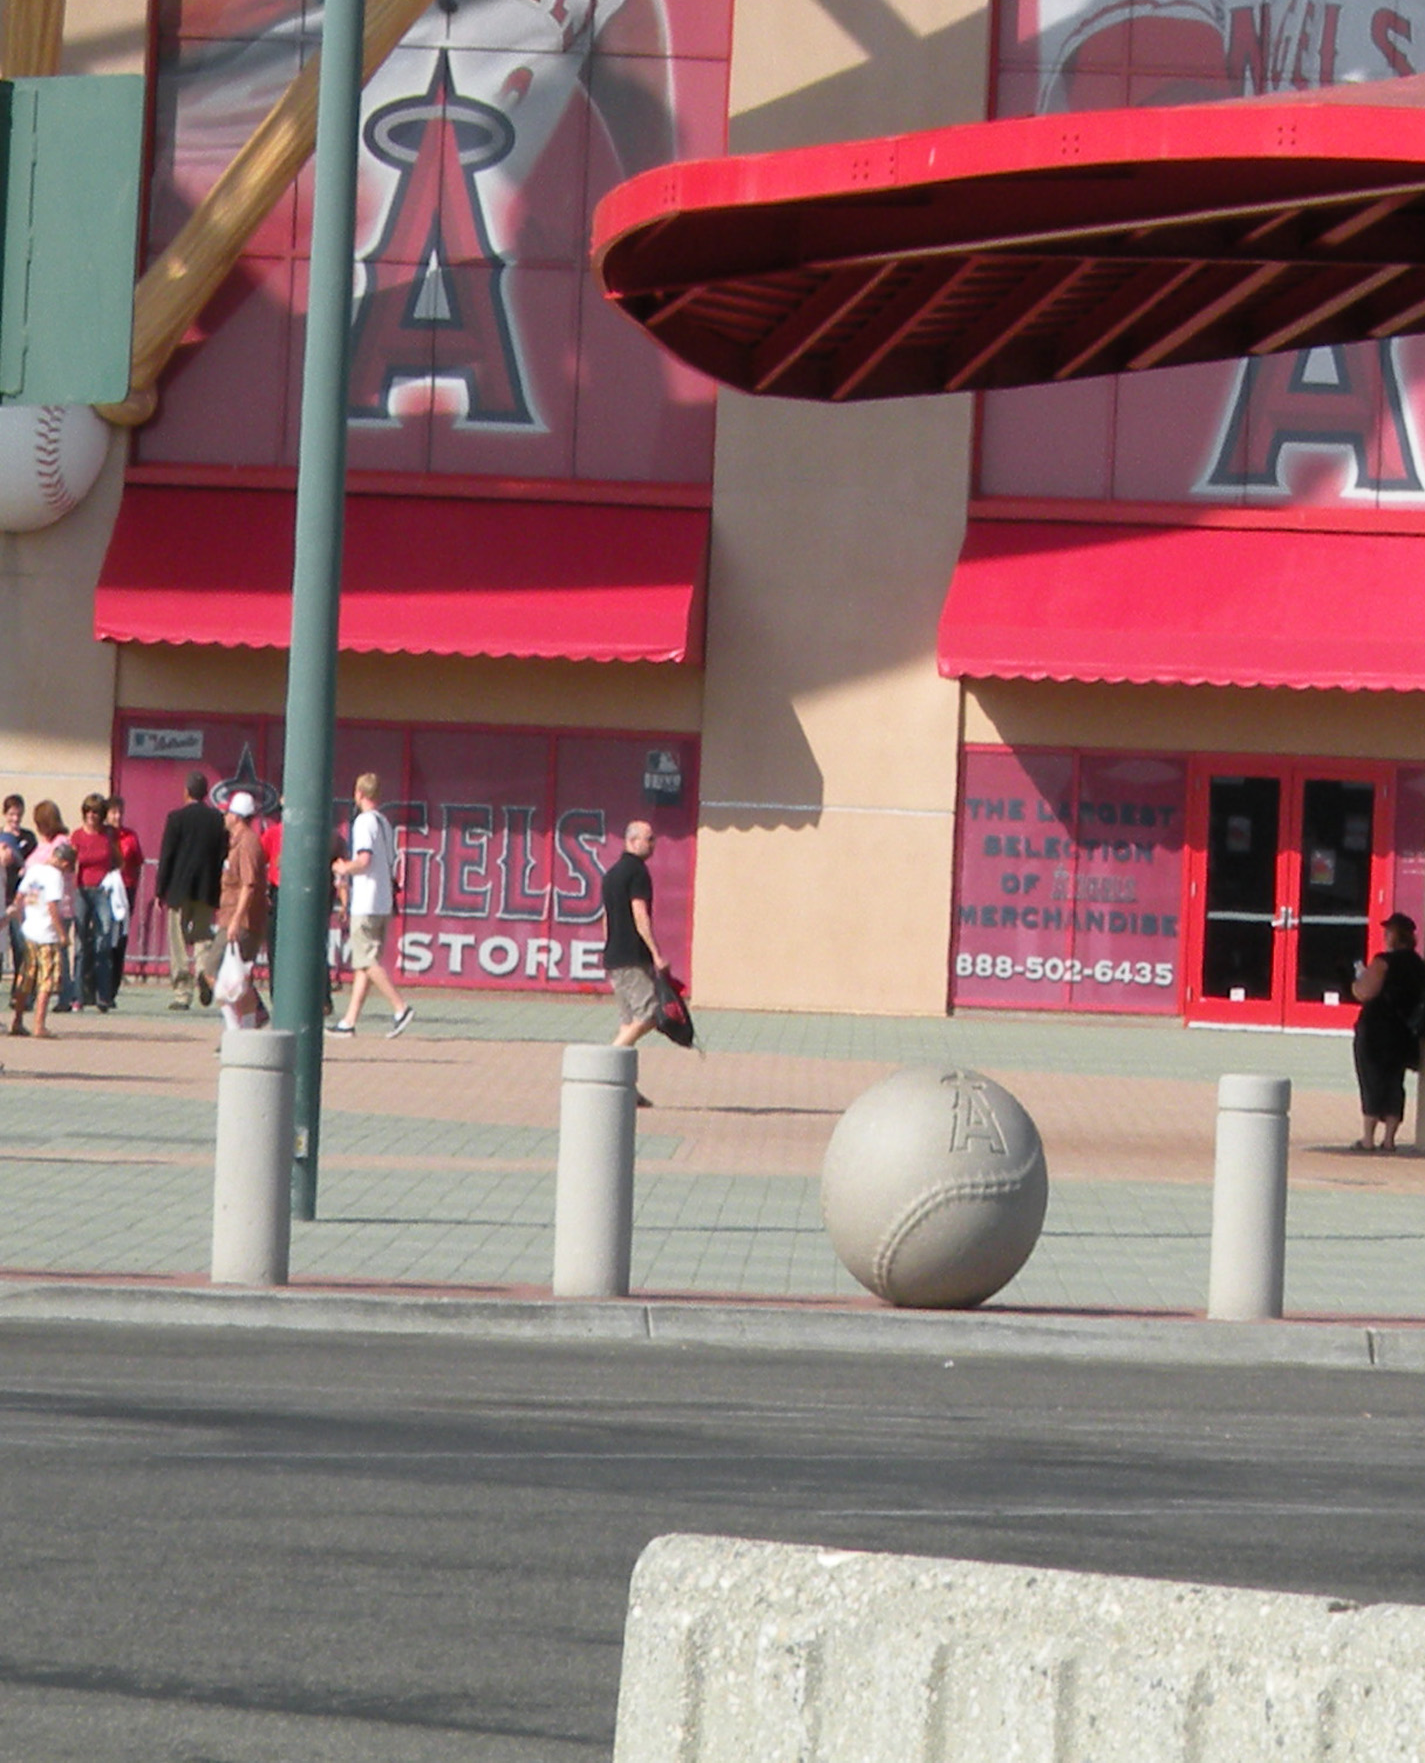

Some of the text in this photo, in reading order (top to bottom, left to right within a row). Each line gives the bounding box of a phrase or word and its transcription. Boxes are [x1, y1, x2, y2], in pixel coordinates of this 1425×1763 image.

[964, 797, 1176, 827] THE LARGEST
[983, 834, 1154, 863] SELECTION
[1000, 872, 1041, 895] OF
[959, 903, 1179, 938] MERCHANDISE
[397, 932, 606, 981] STORE
[955, 953, 1174, 986] 888-502-6435
